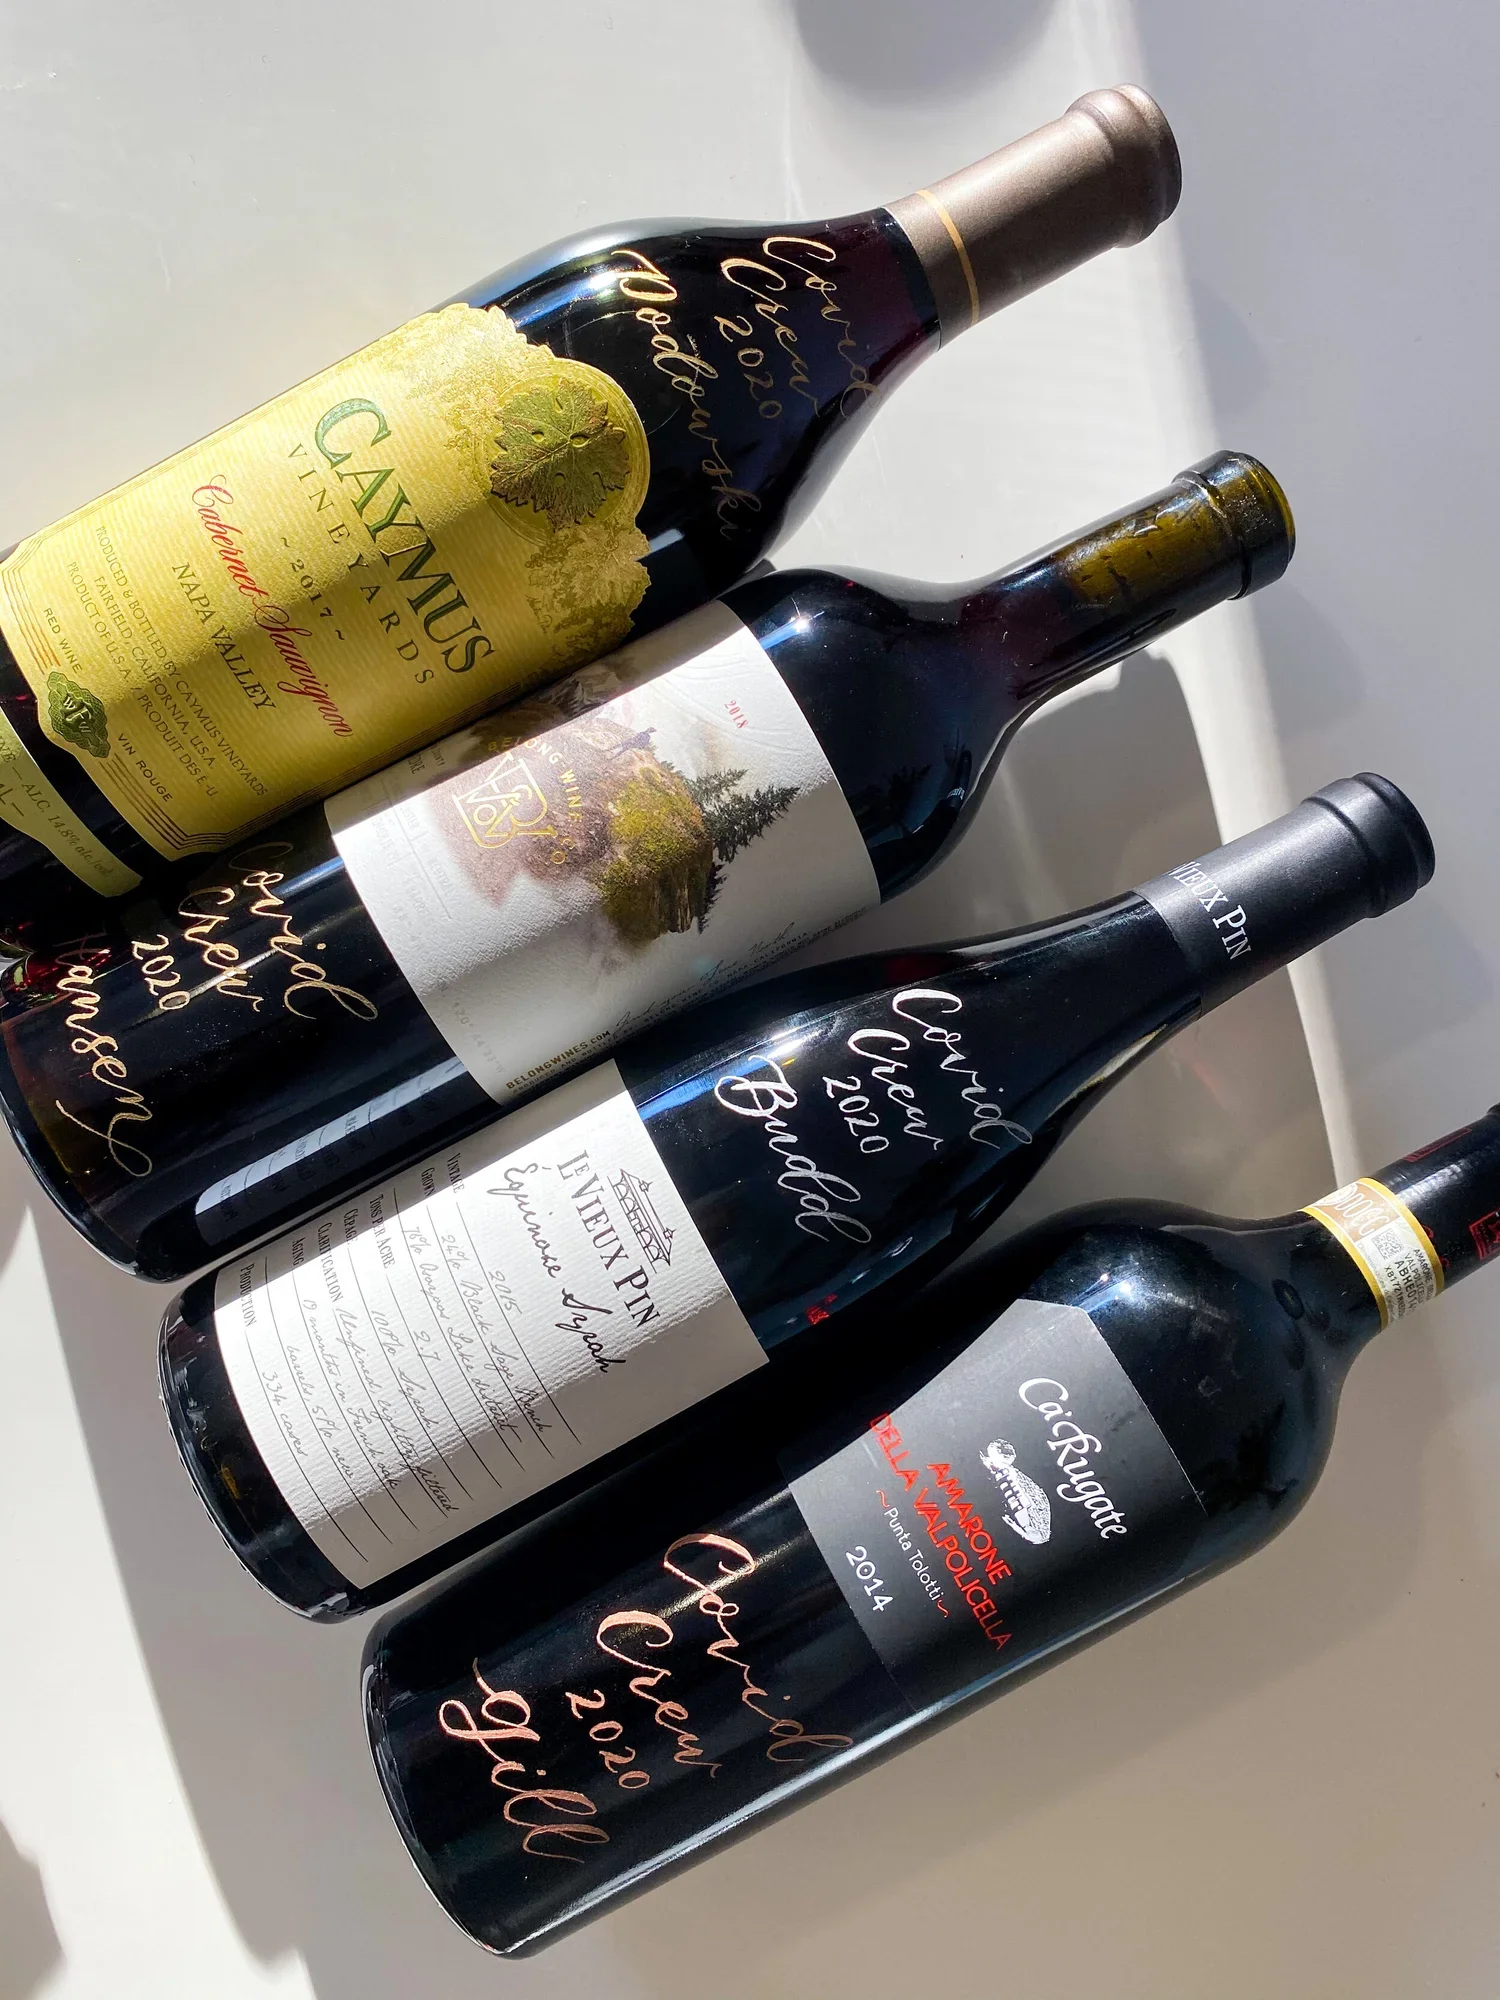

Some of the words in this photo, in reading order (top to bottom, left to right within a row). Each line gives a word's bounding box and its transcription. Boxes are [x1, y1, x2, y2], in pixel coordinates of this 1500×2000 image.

[713, 307, 783, 421] 2020
[719, 257, 825, 416] Crew
[763, 235, 882, 418] Covid
[288, 442, 434, 684] VINEYARDS
[314, 398, 495, 673] CAYMUS
[192, 474, 268, 606] Cabernet
[254, 604, 353, 737] Sauvignon
[289, 559, 333, 617] 2017
[43, 608, 61, 634] RED
[59, 638, 83, 674] WINE
[67, 561, 101, 619] PRODUCT
[94, 620, 113, 642] OF
[106, 638, 137, 683] U.S.A.
[137, 694, 184, 752] PRODUIT
[179, 753, 201, 775] DES
[94, 576, 134, 645] FAIRFIELD,
[132, 646, 189, 735] CALIFORNIA,
[190, 735, 216, 767] U.S.A.
[96, 523, 128, 587] PRODUCED
[121, 587, 134, 600] &
[128, 600, 167, 658] BOTTLED
[161, 660, 181, 677] BY
[176, 680, 221, 738] CAYMUS
[217, 737, 268, 795] VINEYARDS
[172, 562, 216, 625] NAPA
[211, 625, 276, 709] VALLEY
[724, 701, 748, 729] 2018
[118, 733, 136, 755] VIN
[135, 760, 173, 802] ROUGE
[48, 815, 80, 845] 14.8%
[131, 934, 194, 1011] 2020
[178, 887, 264, 1012] Crew
[228, 842, 378, 1021] Covid
[1212, 905, 1251, 960] PIN
[848, 1029, 944, 1150] Crew
[892, 988, 1032, 1147] Covid
[714, 1057, 871, 1243] Budd
[822, 1075, 889, 1153] 2020
[370, 1194, 384, 1218] TONS
[421, 1167, 435, 1197] GROWN
[557, 1149, 590, 1180] LE
[292, 1237, 306, 1266] AGING
[318, 1222, 344, 1302] CLARIFICATION
[372, 1216, 386, 1238] PER
[376, 1237, 395, 1269] ACRE
[441, 1234, 470, 1270] 24%
[447, 1152, 466, 1193] VINTAGE
[484, 1270, 523, 1314] 2015
[571, 1173, 629, 1271] VIEUX
[303, 1299, 318, 1310] 19
[344, 1208, 358, 1242] CÉPAGE
[367, 1309, 405, 1356] 100%
[393, 1367, 434, 1429] Syrah
[455, 1280, 490, 1335] Black
[555, 1289, 626, 1373] Syrah
[613, 1265, 660, 1328] PIN
[239, 1263, 257, 1327] PRODUCTION
[262, 1372, 287, 1406] 334
[280, 1413, 308, 1456] cases
[304, 1316, 340, 1376] months
[411, 1331, 441, 1361] 2.7
[447, 1327, 474, 1373] Lake
[471, 1378, 522, 1443] district
[484, 1341, 518, 1379] Sage
[286, 1345, 313, 1402] barrels,
[332, 1447, 355, 1479] new
[335, 1382, 350, 1403] in
[346, 1408, 382, 1459] French
[514, 1385, 552, 1432] Bench
[377, 1462, 399, 1489] oak
[868, 1411, 920, 1492] DELLA
[914, 1487, 1011, 1650] VALPOLICELLA
[884, 1507, 912, 1551] Punta
[909, 1549, 944, 1600] Tolotti
[927, 1464, 1013, 1585] AMARONE
[846, 1546, 893, 1611] 2014
[662, 1535, 853, 1761] Covid
[596, 1611, 722, 1778] Crew
[565, 1689, 650, 1789] 2020
